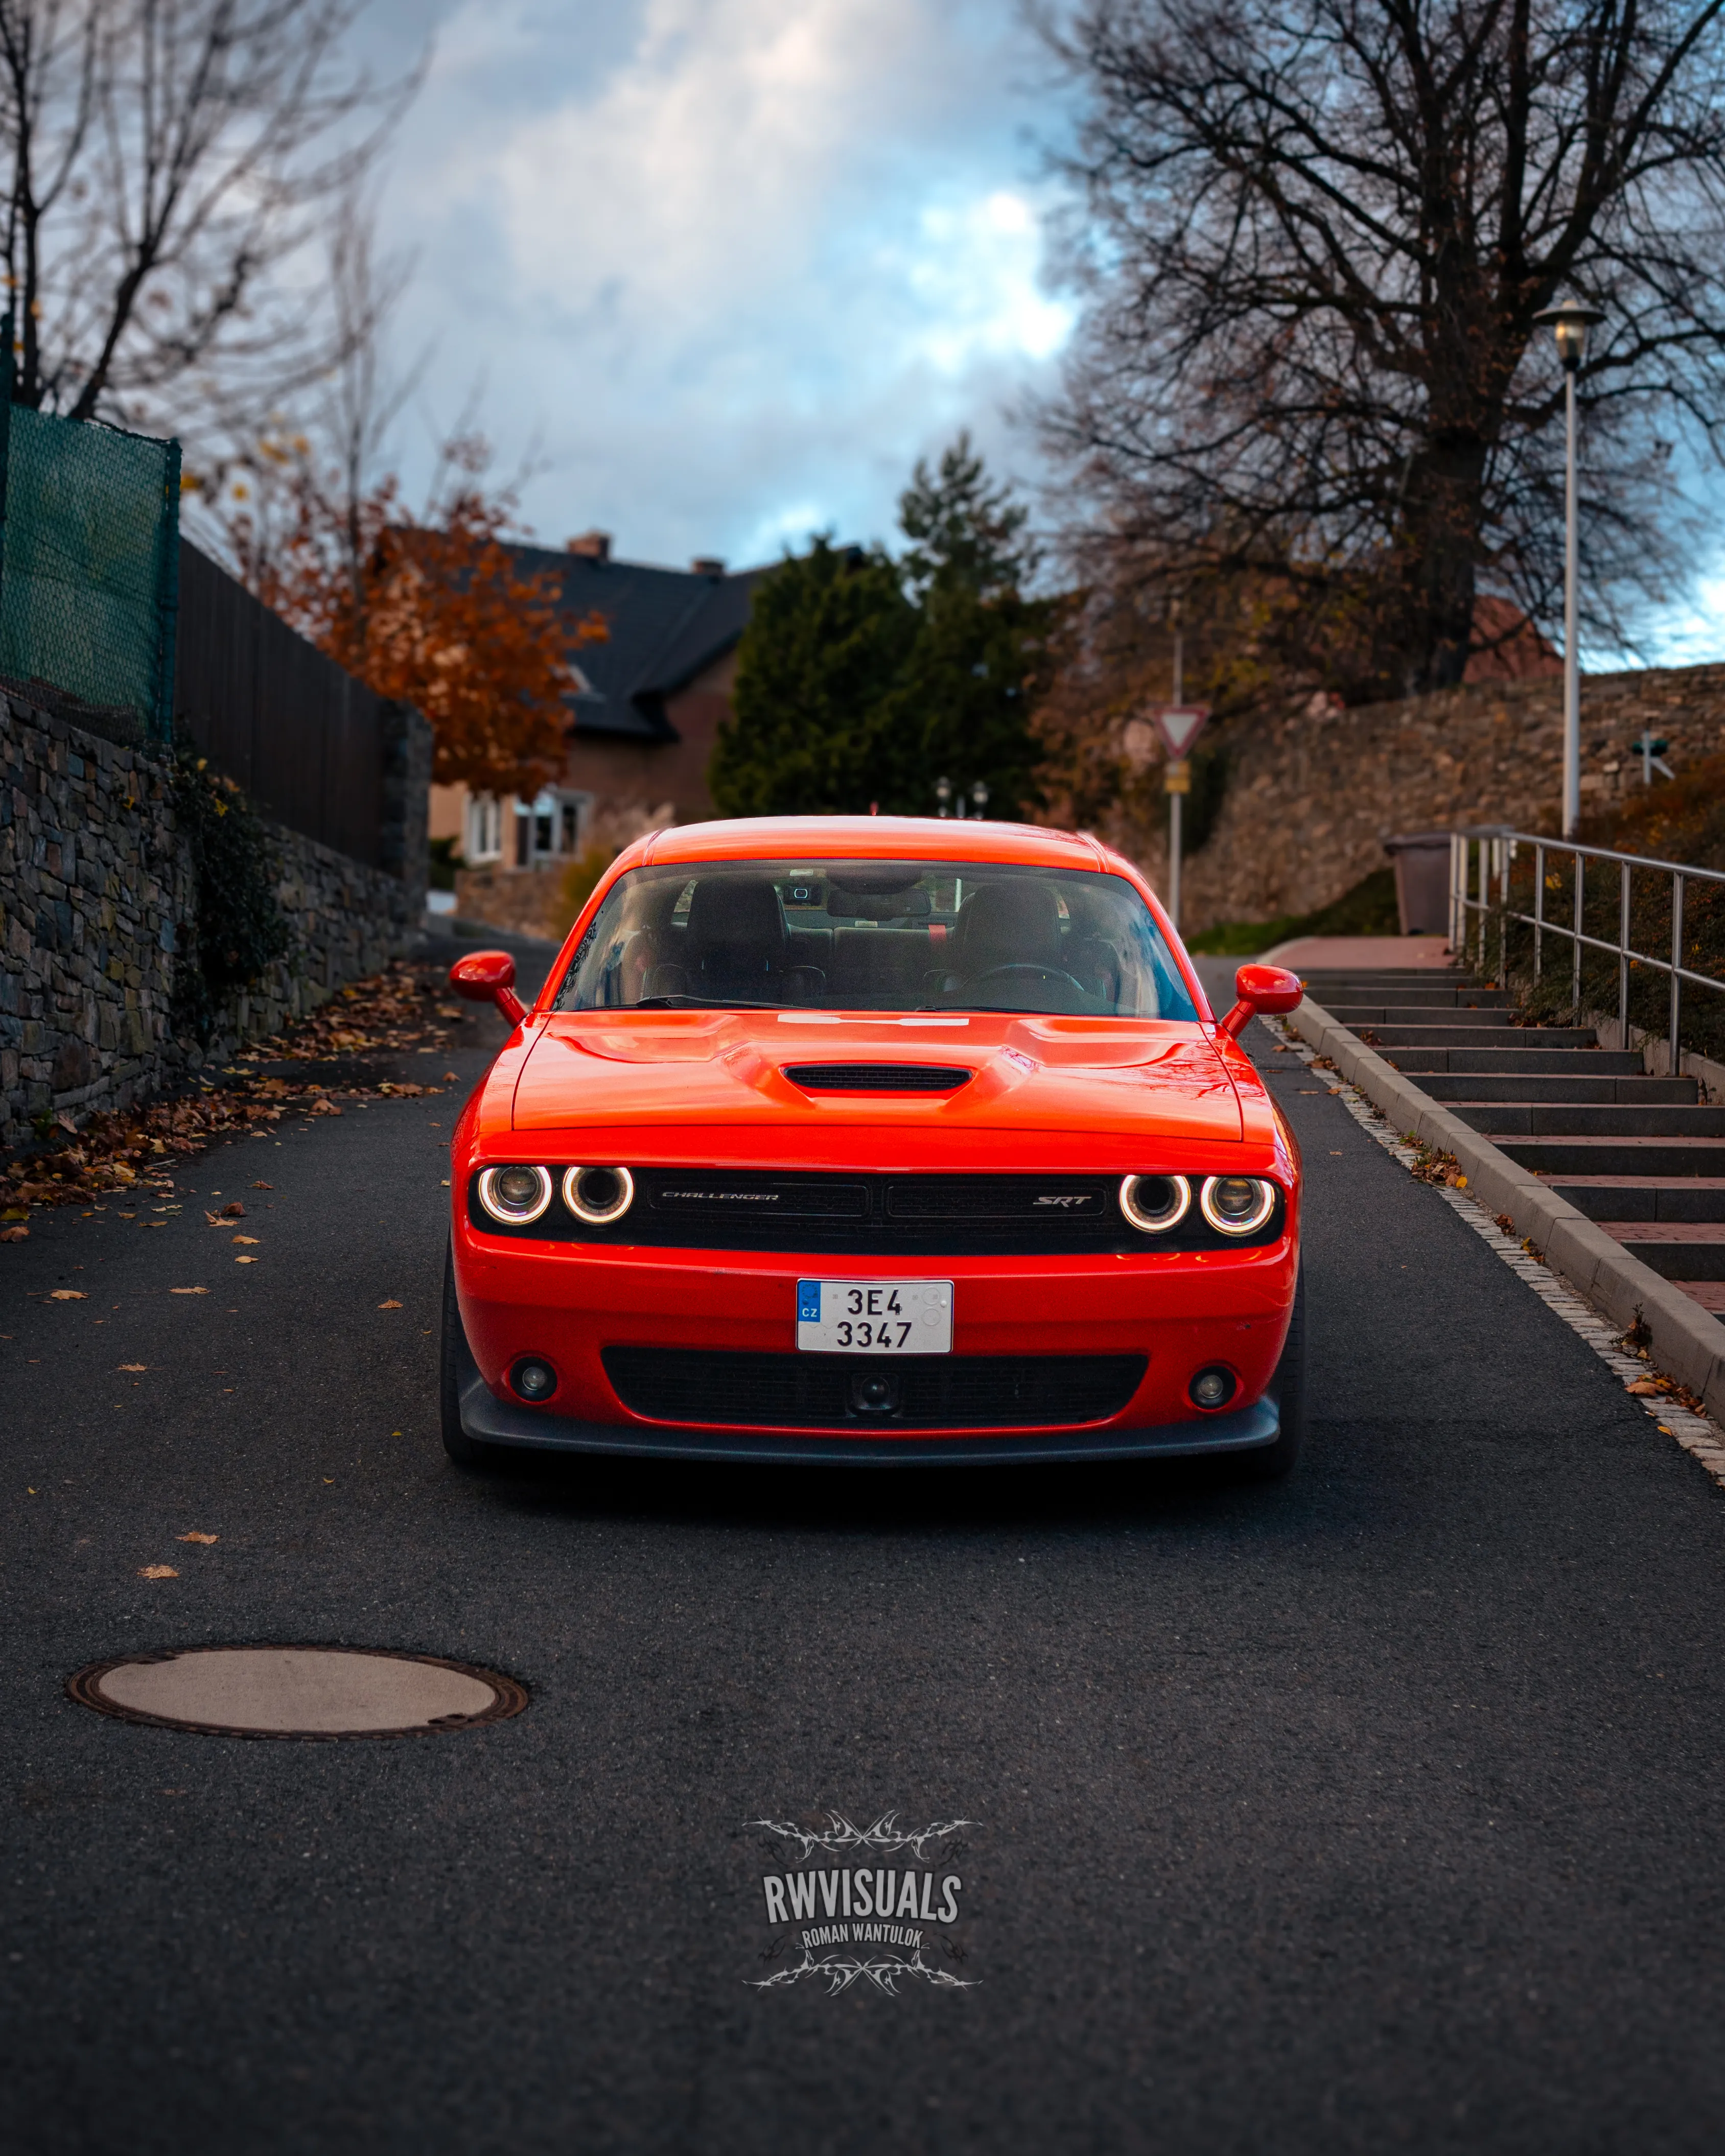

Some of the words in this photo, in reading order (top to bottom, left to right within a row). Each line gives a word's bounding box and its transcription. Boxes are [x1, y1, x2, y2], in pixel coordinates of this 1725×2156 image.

[662, 1192, 779, 1200] CHALLENGER
[1033, 1197, 1092, 1207] SRT
[847, 1288, 901, 1316] 3E4
[802, 1308, 818, 1318] CZ
[837, 1321, 912, 1348] 3347
